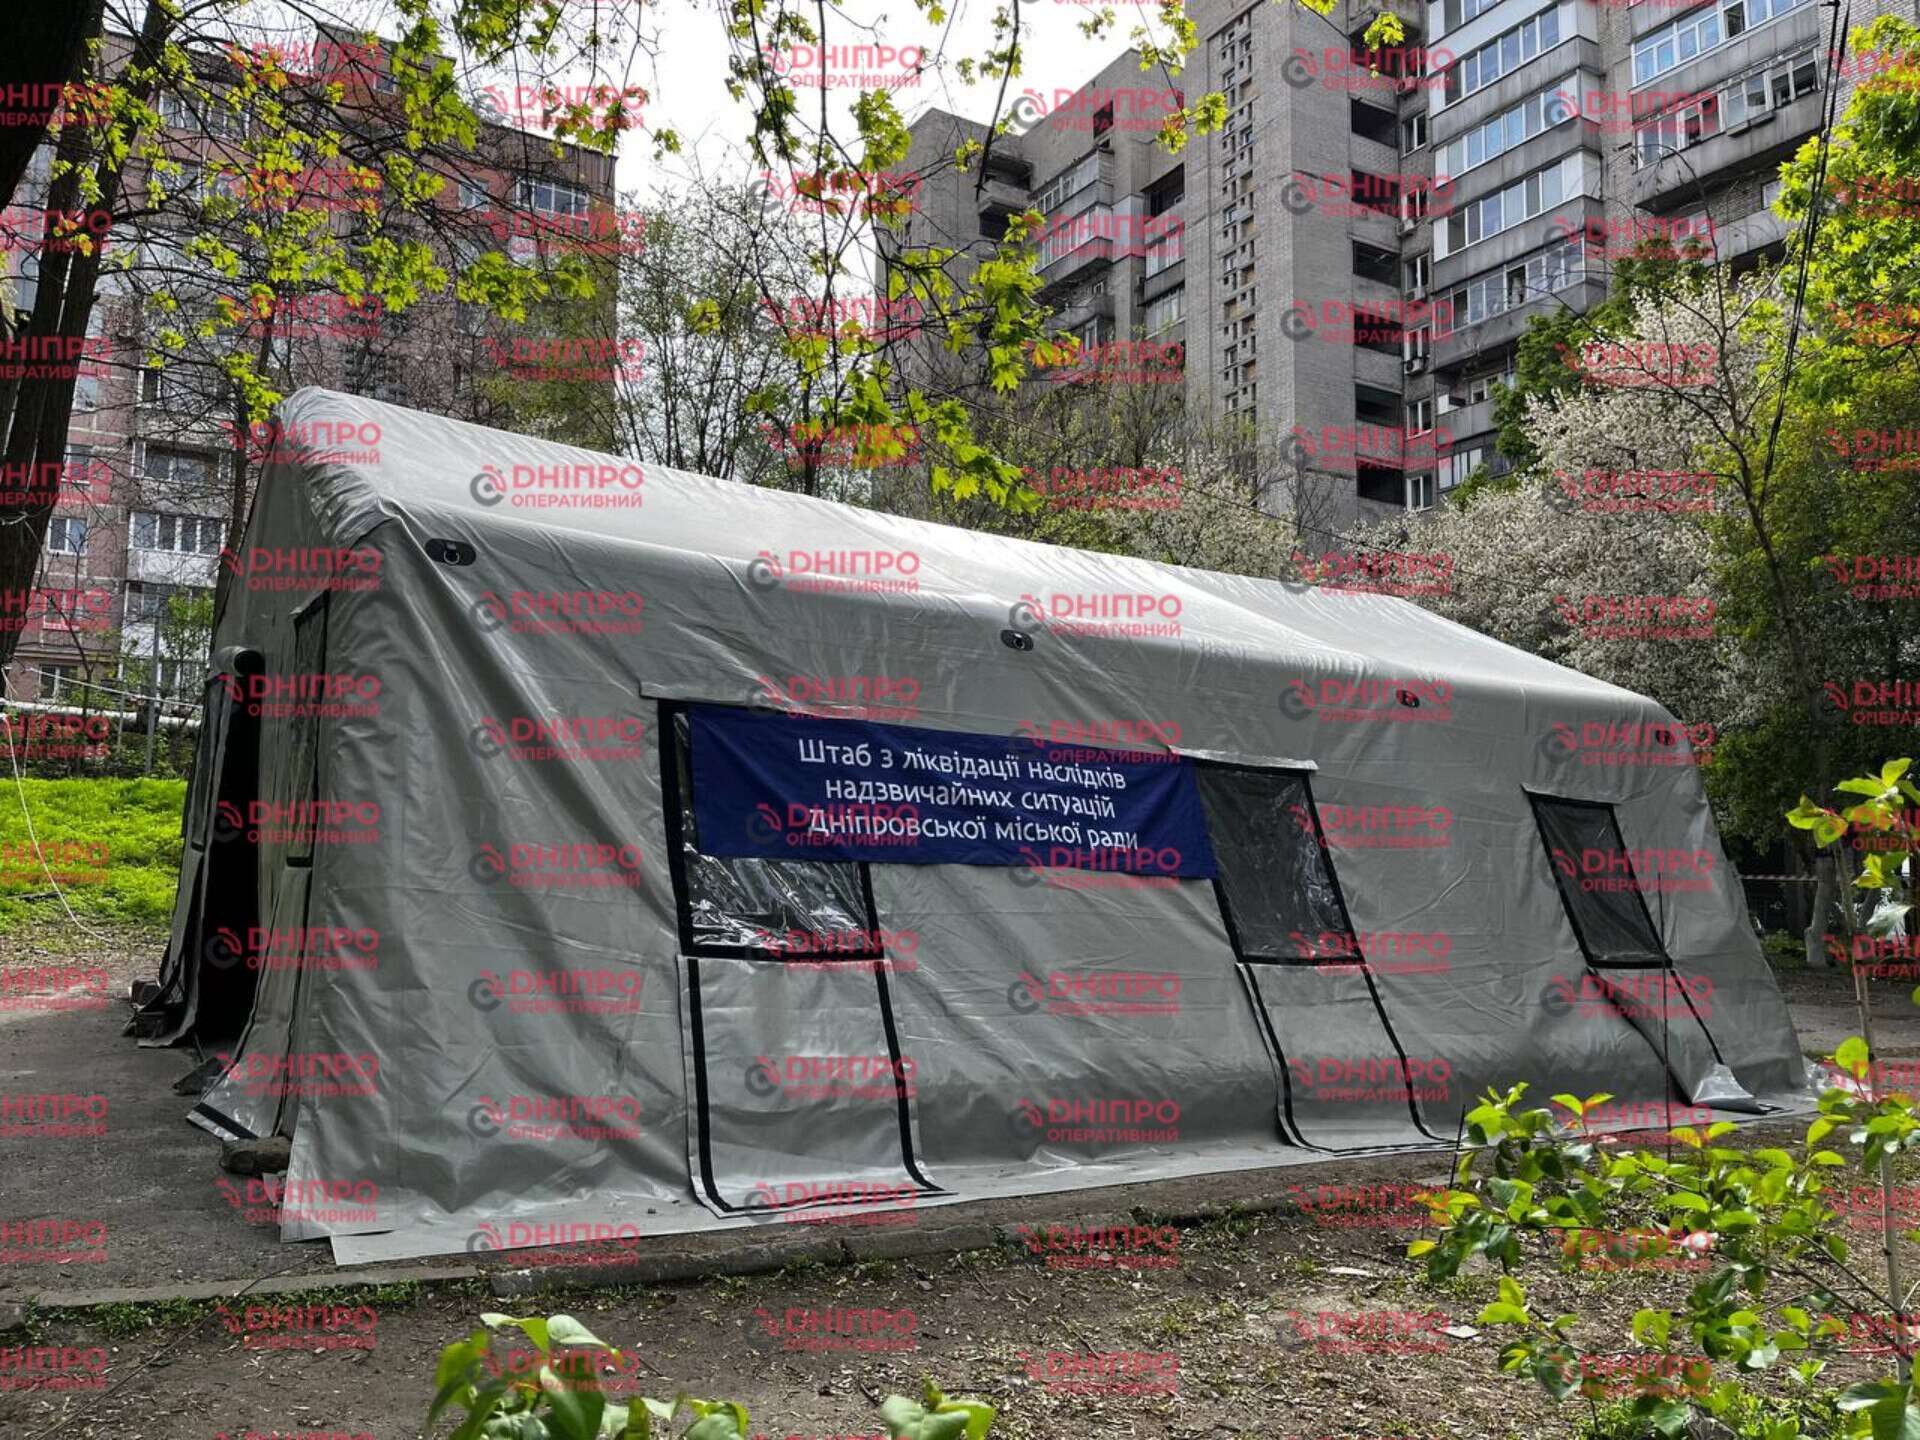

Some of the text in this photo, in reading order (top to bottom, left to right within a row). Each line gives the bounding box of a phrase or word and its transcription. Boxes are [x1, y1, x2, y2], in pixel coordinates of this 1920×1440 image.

[799, 738, 871, 767] Штаб
[903, 747, 1020, 781] ліквідації
[1028, 761, 1126, 789] наслідків
[826, 779, 1116, 820] надзвичайних ситуацій
[807, 808, 1138, 852] Дніпровської міської ради
